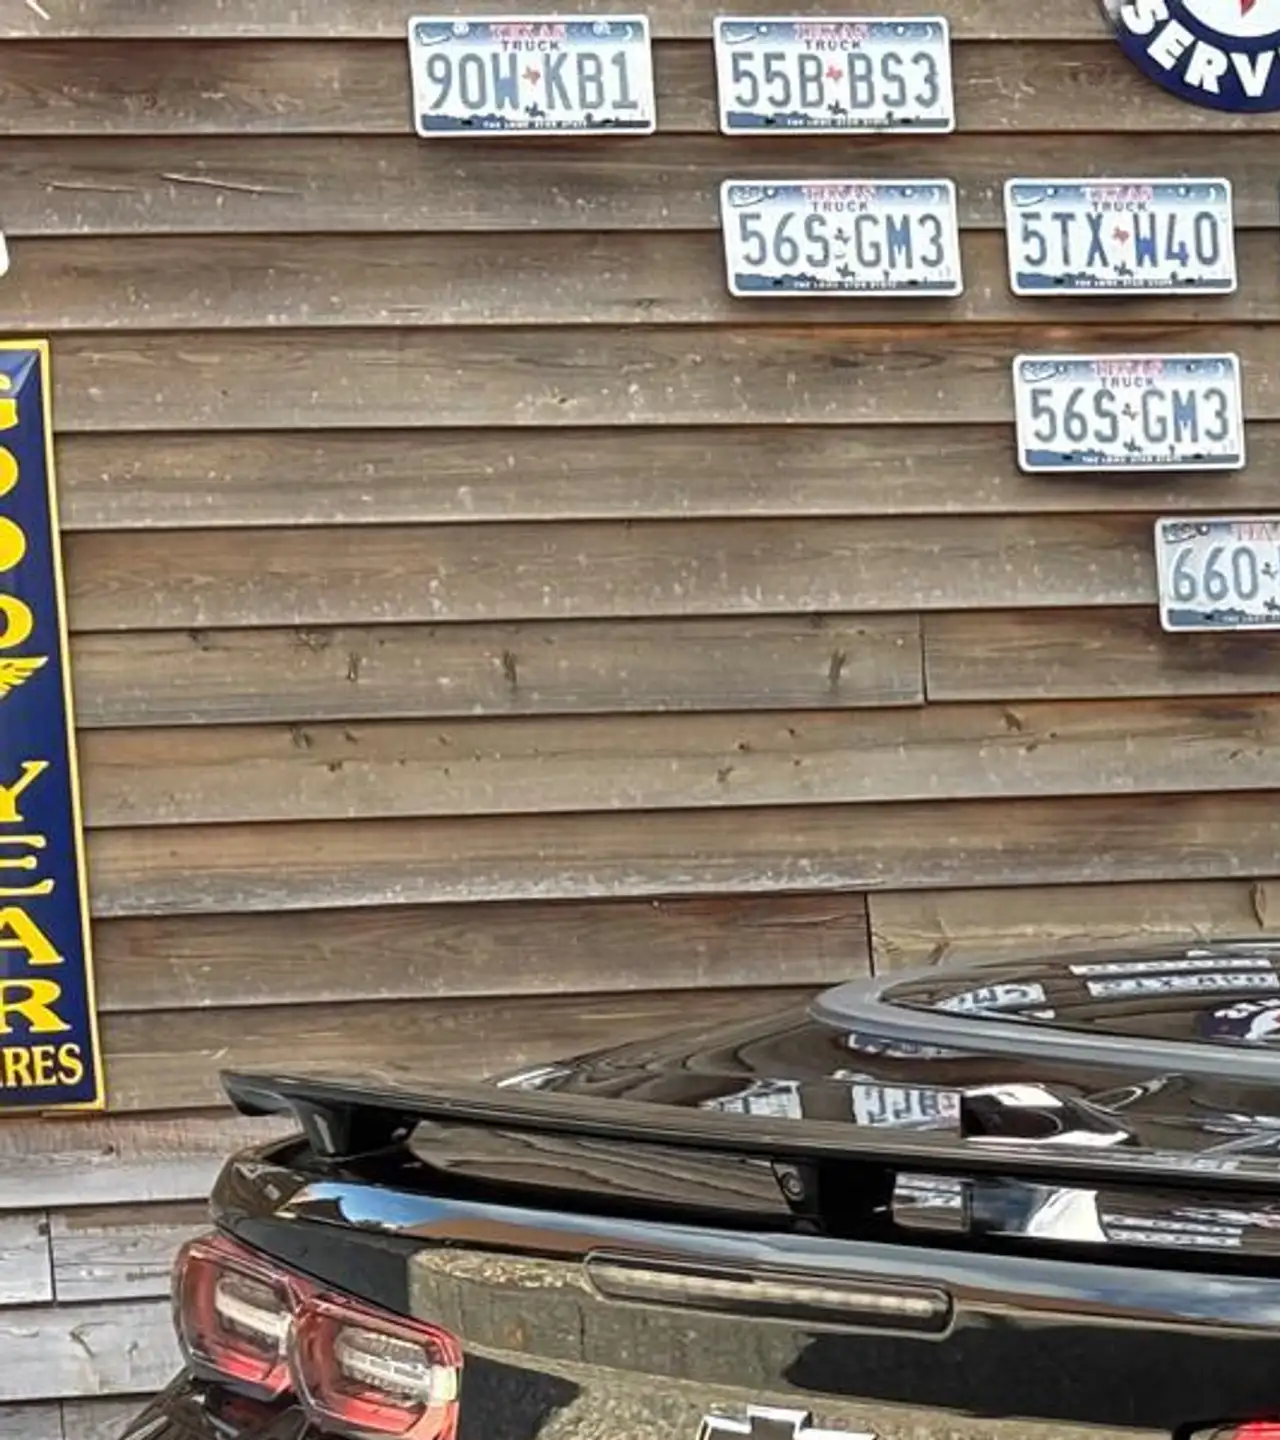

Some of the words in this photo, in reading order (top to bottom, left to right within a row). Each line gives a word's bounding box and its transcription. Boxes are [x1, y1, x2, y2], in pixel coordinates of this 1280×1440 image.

[501, 40, 562, 51] TRUCK
[804, 40, 863, 51] TRUCK
[811, 201, 868, 212] TRUCK
[1091, 201, 1149, 212] TRUCK
[1172, 545, 1259, 601] 660
[0, 1041, 84, 1088] RES
